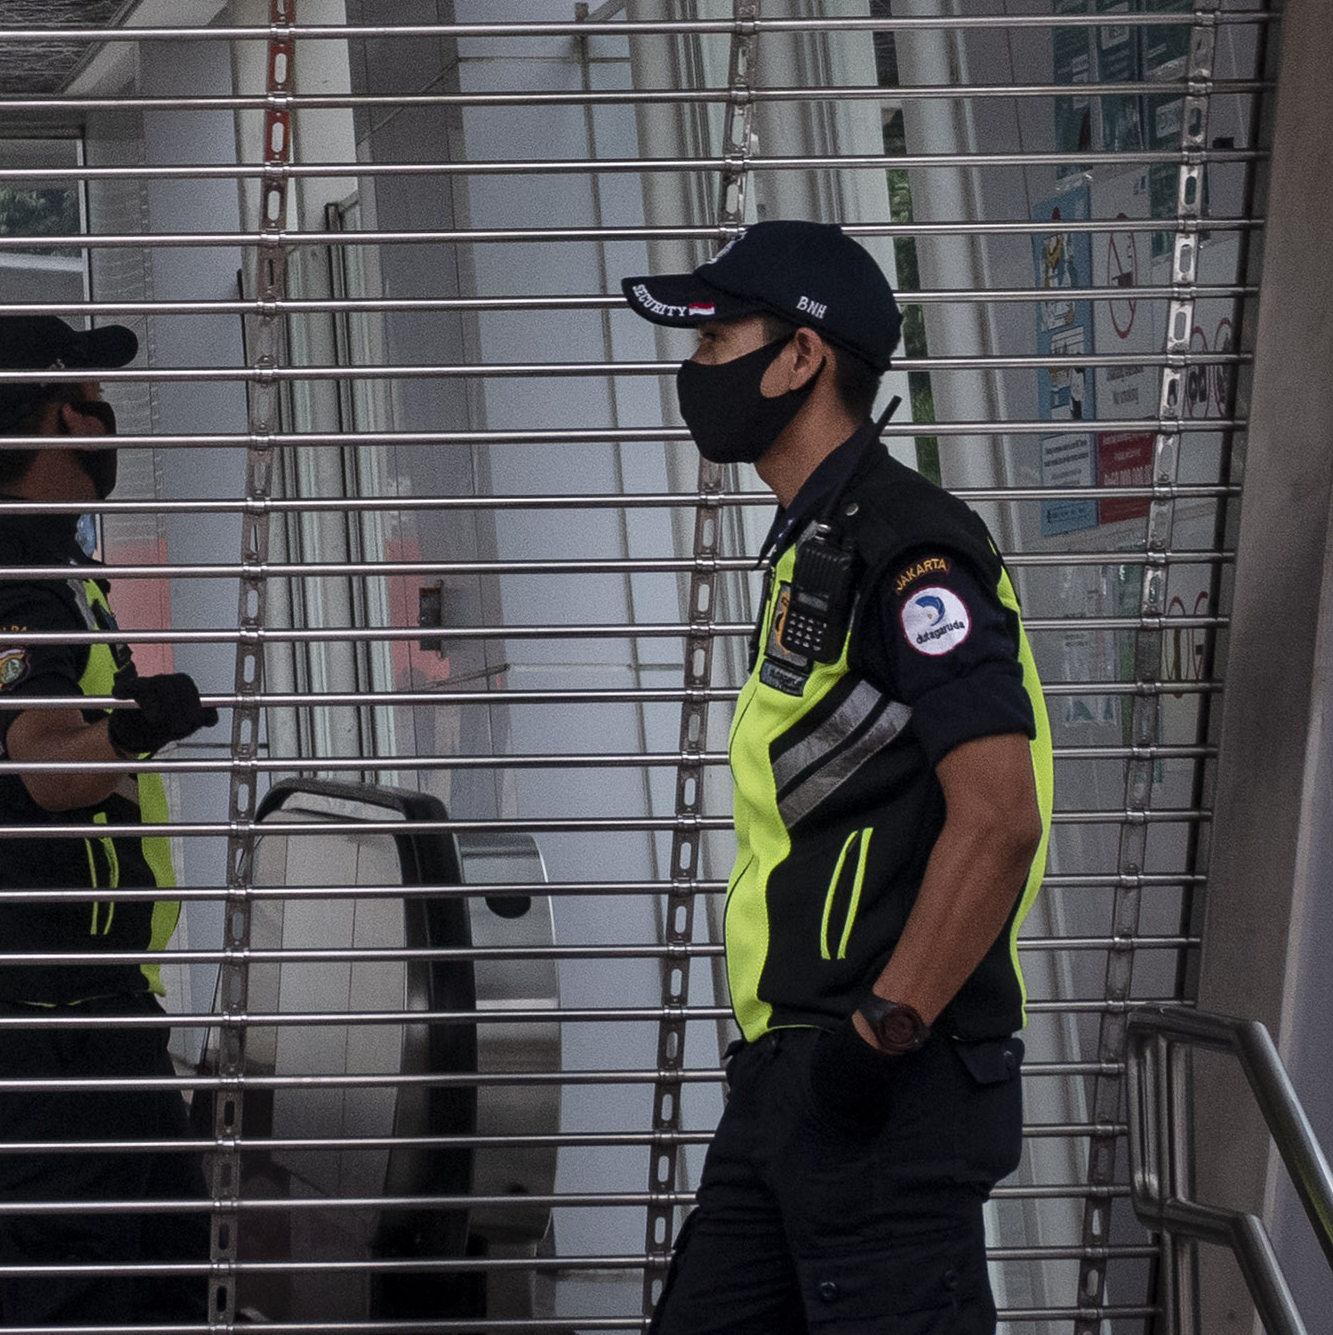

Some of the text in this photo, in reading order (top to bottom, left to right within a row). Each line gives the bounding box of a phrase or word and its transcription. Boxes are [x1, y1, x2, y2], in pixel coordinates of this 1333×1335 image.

[632, 283, 687, 317] SECURITY
[796, 295, 828, 319] BNH
[896, 558, 947, 591] JAKARTA
[916, 619, 966, 645] dutagaruda
